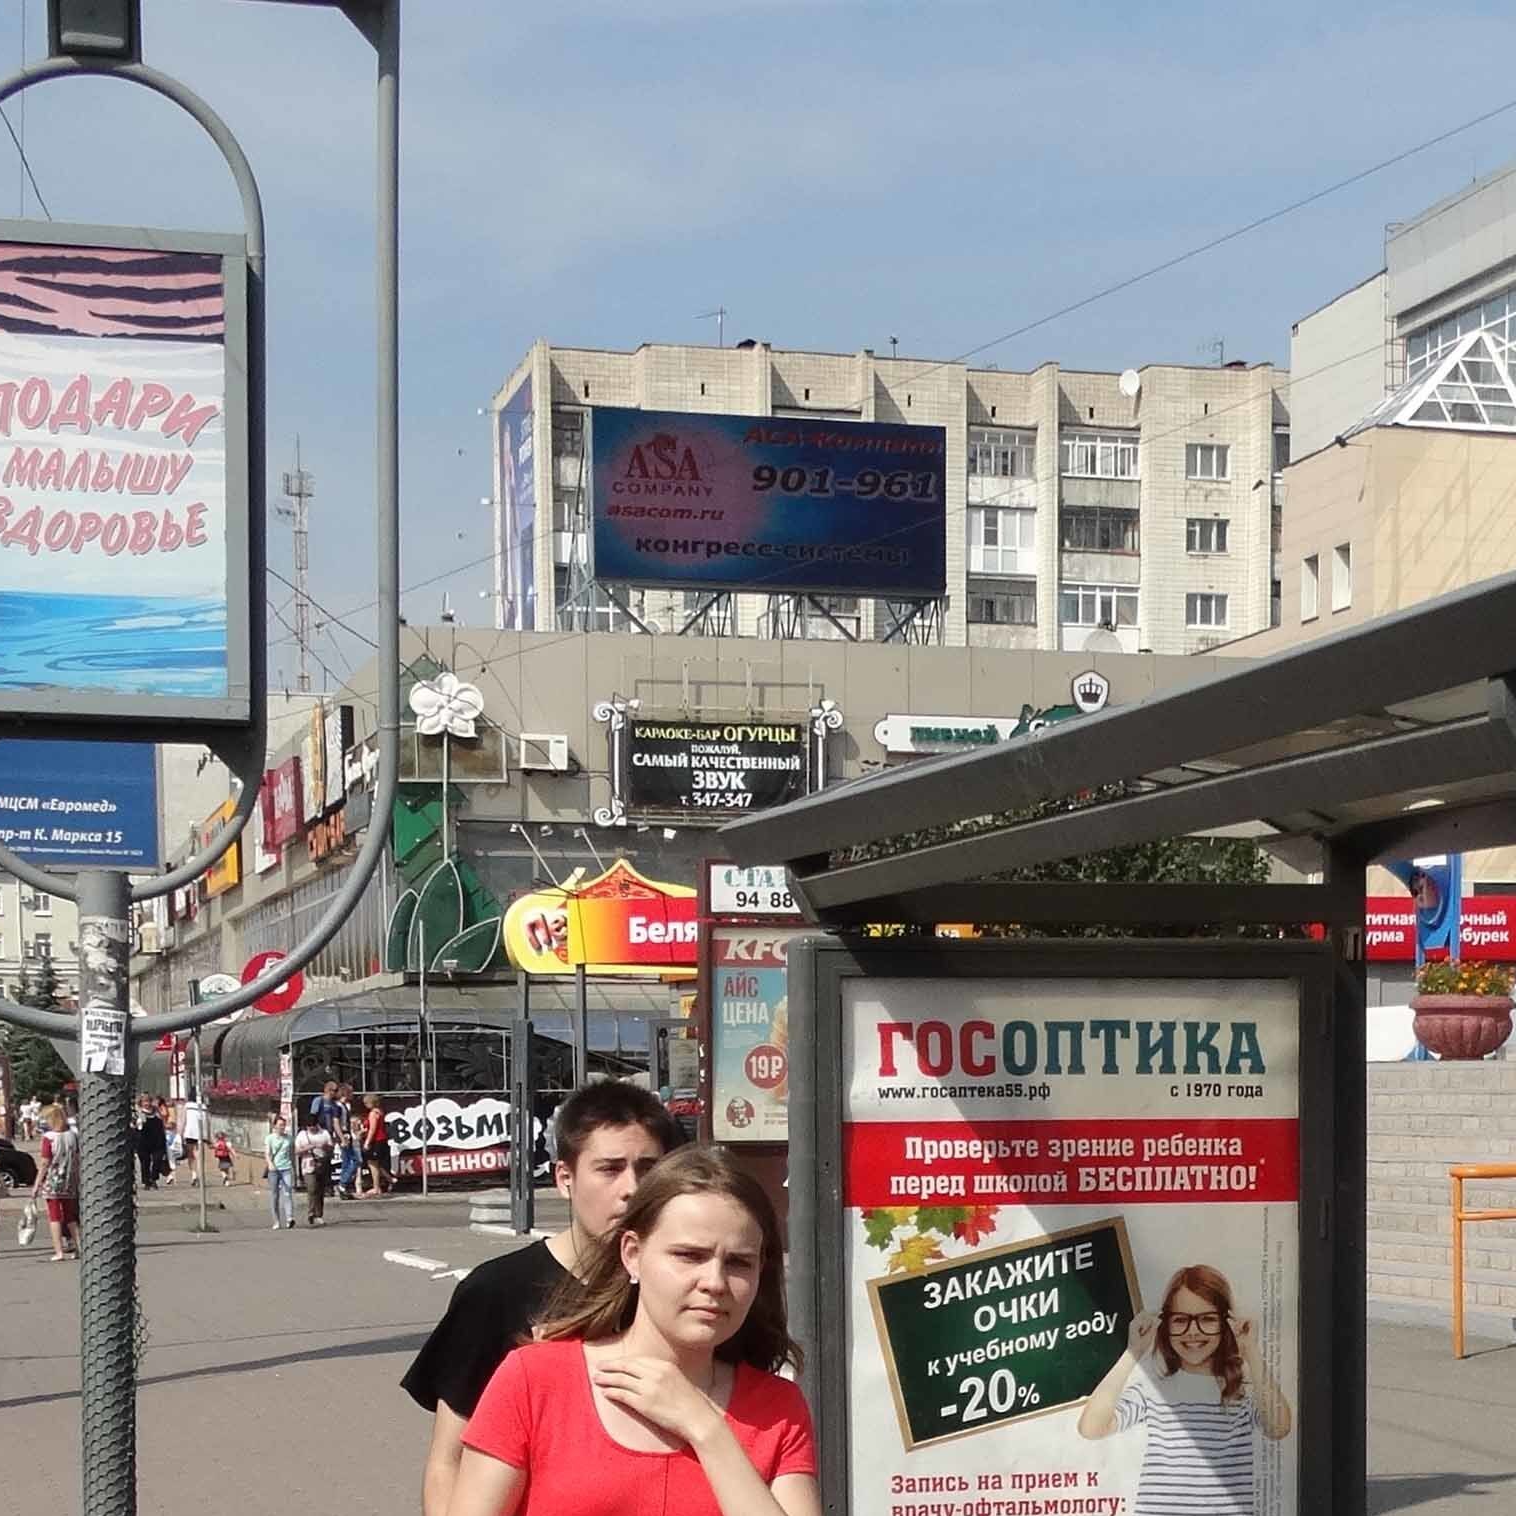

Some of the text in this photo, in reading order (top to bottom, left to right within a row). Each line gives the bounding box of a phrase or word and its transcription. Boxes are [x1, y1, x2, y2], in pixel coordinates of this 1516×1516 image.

[626, 433, 703, 482] ASA
[2, 447, 194, 495] МАЛЫШУ
[751, 464, 938, 500] 901-961
[612, 482, 714, 498] COMPANY
[606, 504, 725, 521] asacom.ru
[634, 726, 797, 746] КАРАОКЕ-БАР ОГУРЦЫ
[633, 752, 801, 771] САМЫЙ КАЧЕСТВЕННЫЙ
[691, 771, 747, 790] ЗВУК
[42, 799, 117, 814] «Евромед»
[692, 792, 753, 808] 347-347
[34, 828, 48, 842] К.
[51, 829, 102, 844] Маркса
[106, 831, 123, 844] 15
[723, 940, 788, 962] KFC
[723, 970, 759, 998] АЙС
[722, 1001, 770, 1026] ЦЕНА
[877, 1020, 1266, 1078] ГОСОПТИКА
[877, 1082, 1051, 1101] www.госаптека55.рф
[1185, 1082, 1222, 1098] 1970
[1227, 1084, 1264, 1099] года
[905, 1134, 1242, 1164] Проверьте зрение ребенка
[890, 1165, 1257, 1200] перед школой БЕСПЛАТНО!
[923, 1242, 1093, 1308] ЗАКАЖИТЕ
[973, 1287, 1060, 1332] ОЧКИ
[927, 1311, 1118, 1377] к учебному году
[940, 1367, 1040, 1423] -20%
[891, 1471, 1099, 1494] Запись на прием к
